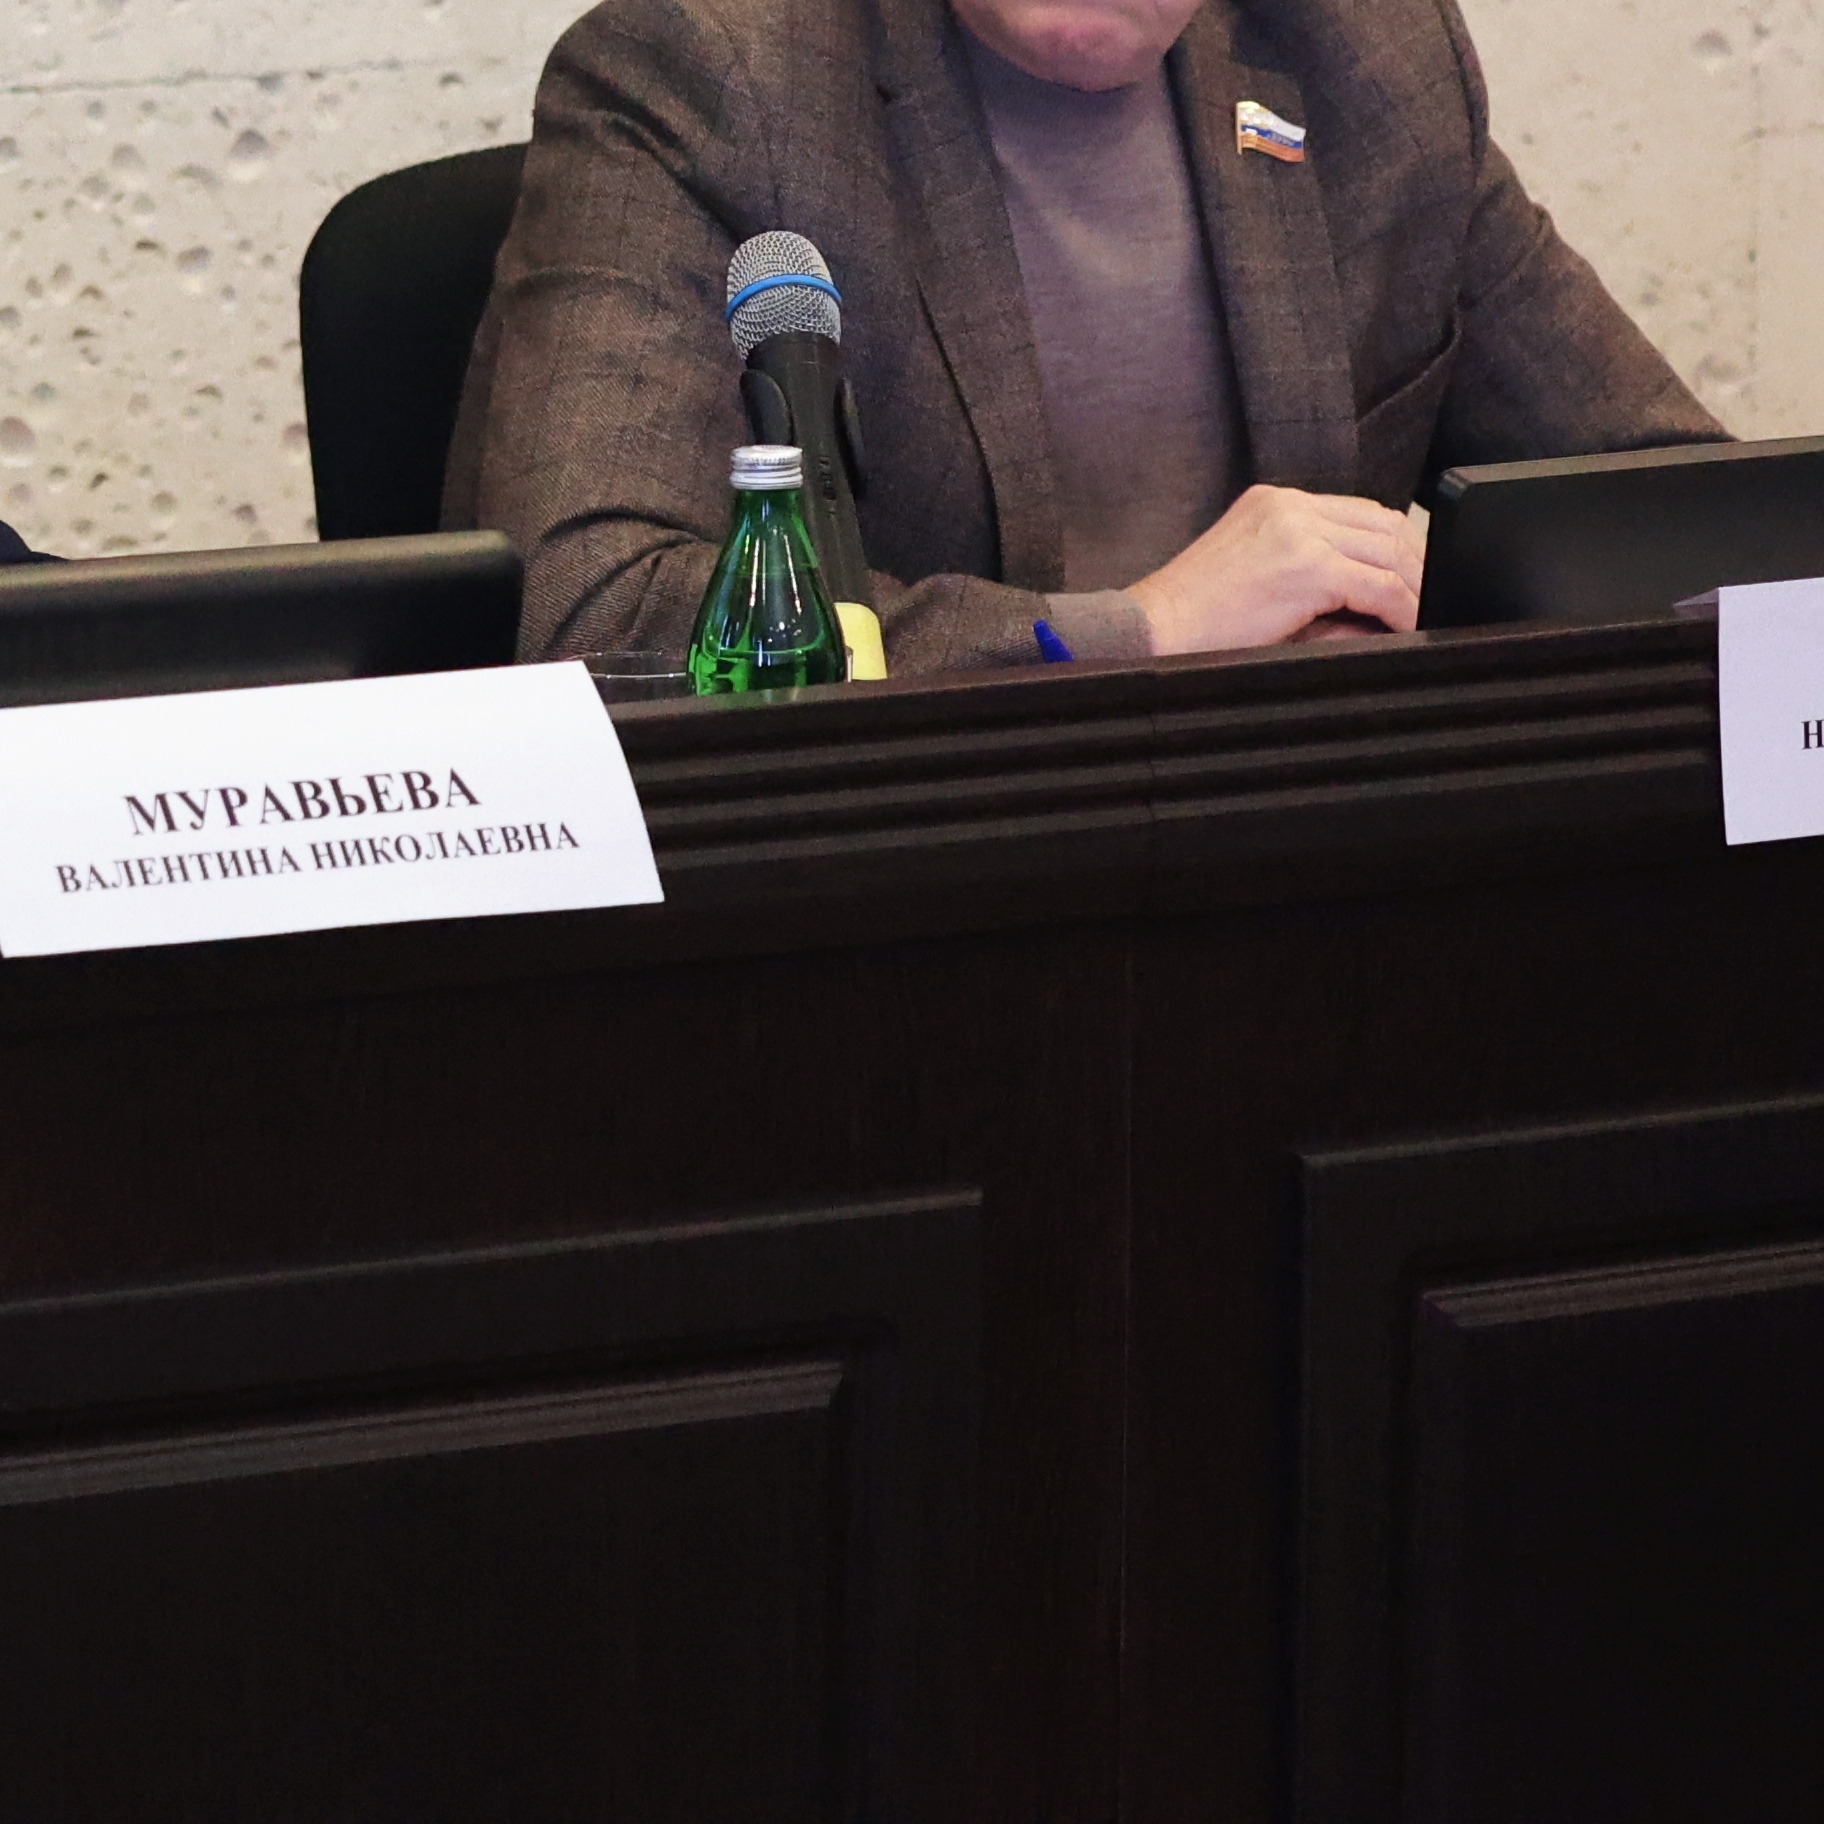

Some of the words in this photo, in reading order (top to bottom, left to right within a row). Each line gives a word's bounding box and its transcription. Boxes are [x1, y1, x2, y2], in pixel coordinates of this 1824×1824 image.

[123, 768, 482, 837] МУРАВЬЕВА
[54, 845, 303, 894] ВАЛЕНТИНА
[309, 822, 581, 871] НИКОЛАЕВНА
